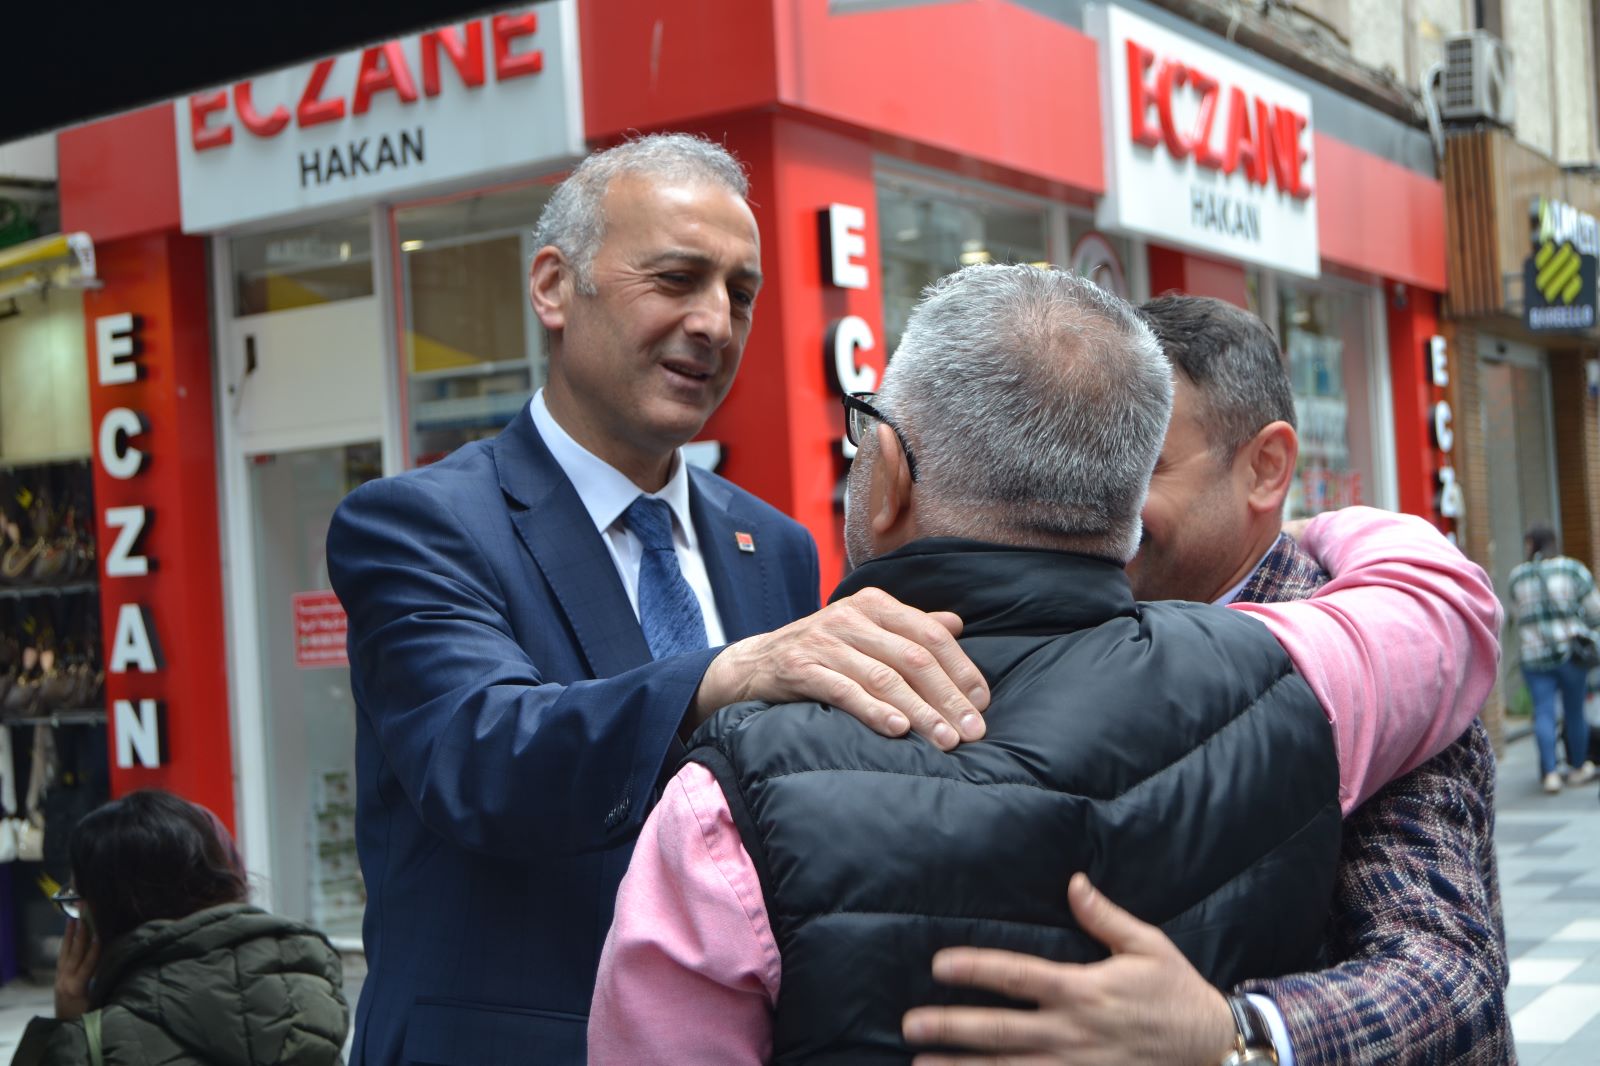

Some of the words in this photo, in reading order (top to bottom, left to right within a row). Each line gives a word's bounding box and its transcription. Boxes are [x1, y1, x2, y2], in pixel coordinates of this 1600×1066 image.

[189, 12, 543, 151] ECZANE
[1126, 38, 1312, 203] ECZANE
[299, 127, 425, 187] HAKAN
[1190, 185, 1261, 241] HAKAN
